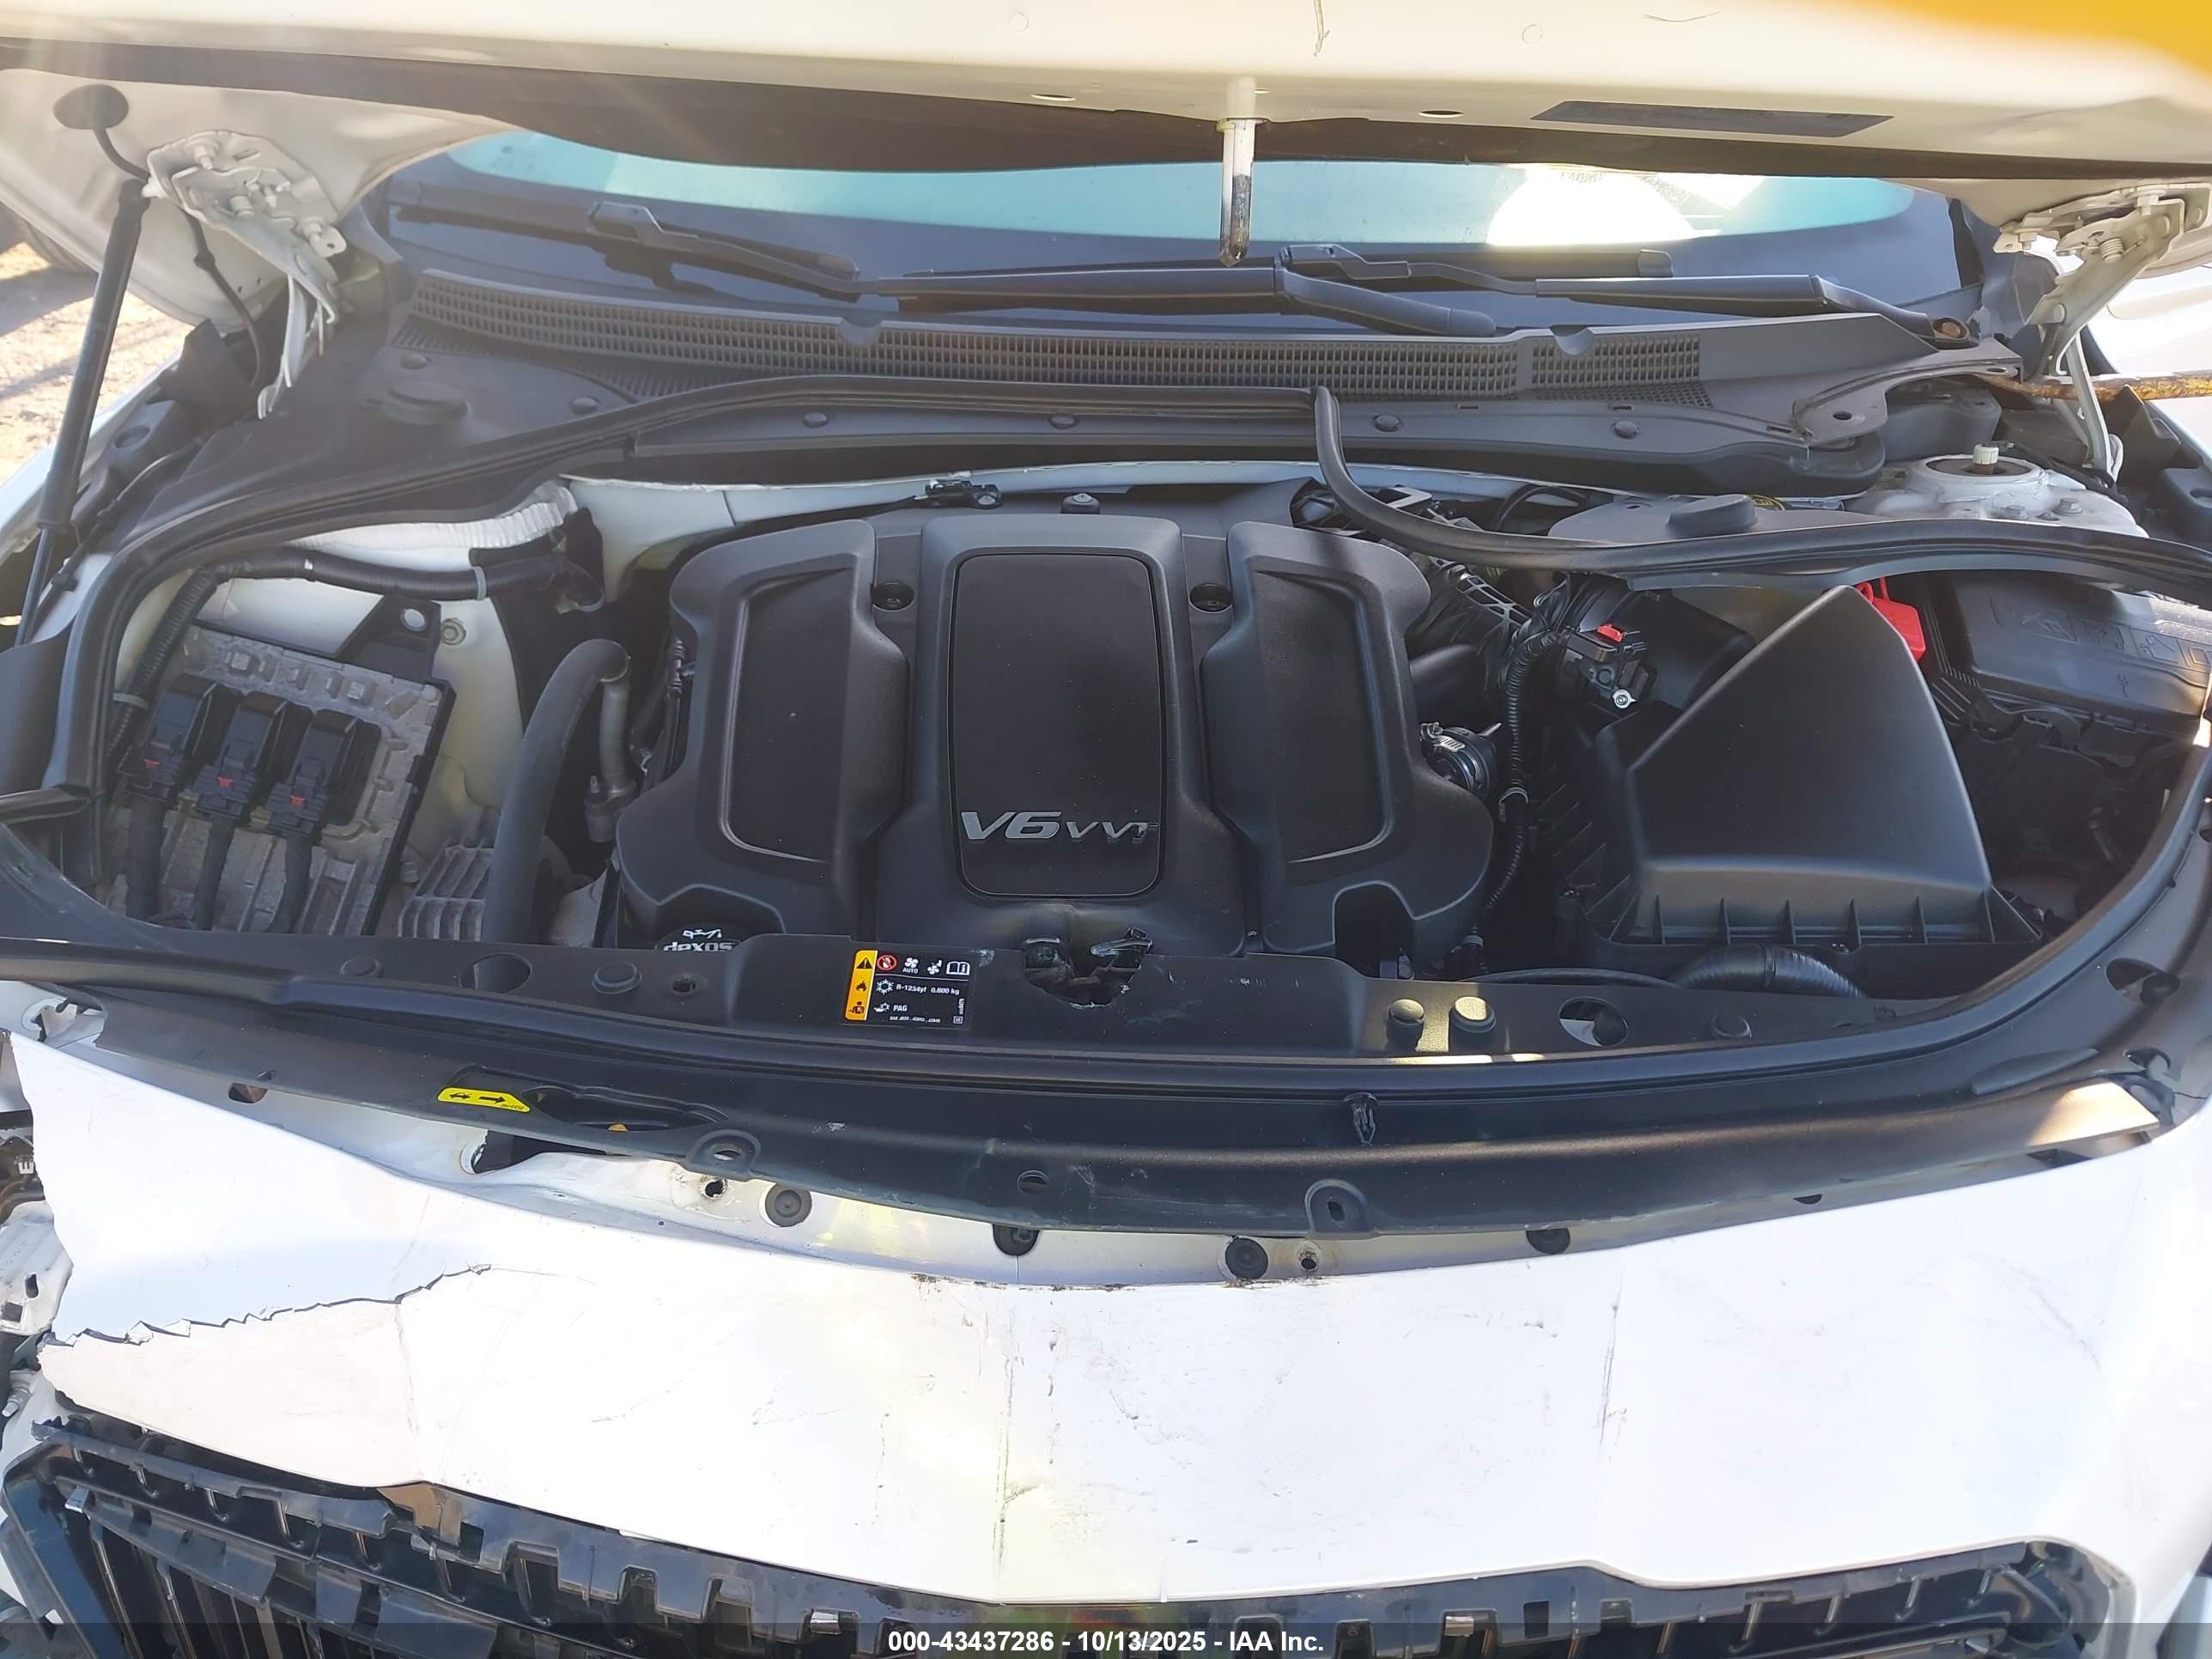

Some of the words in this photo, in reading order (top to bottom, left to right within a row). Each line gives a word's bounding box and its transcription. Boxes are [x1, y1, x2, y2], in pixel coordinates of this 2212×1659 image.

[961, 811, 1062, 840] V6
[663, 941, 732, 952] dexos
[896, 983, 927, 994] R-1234yf
